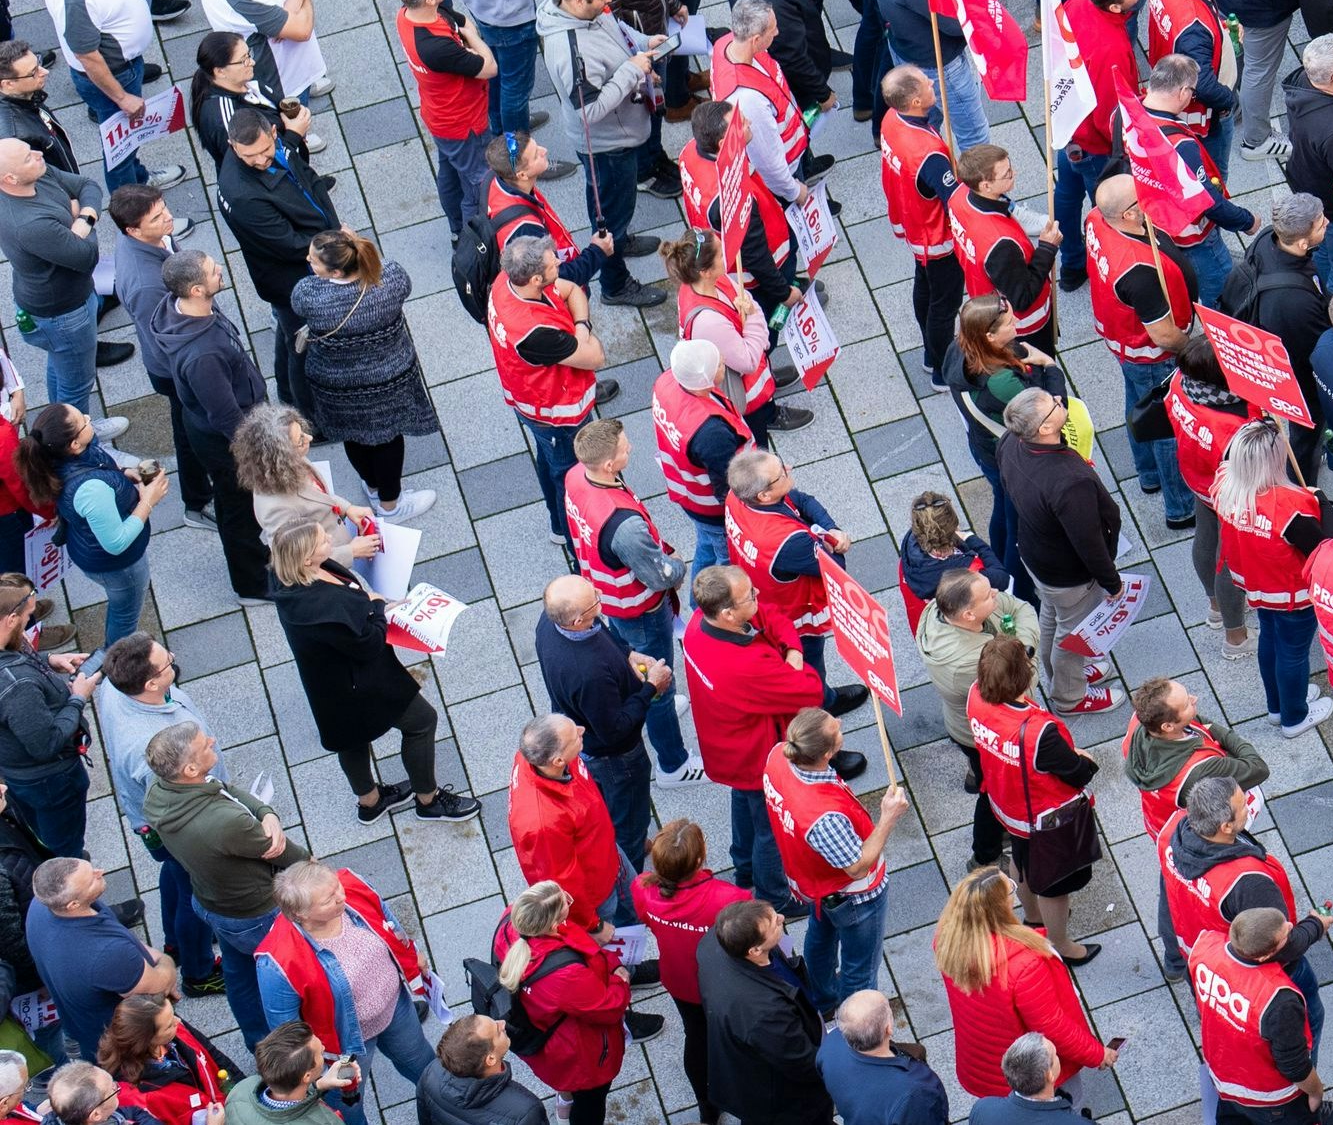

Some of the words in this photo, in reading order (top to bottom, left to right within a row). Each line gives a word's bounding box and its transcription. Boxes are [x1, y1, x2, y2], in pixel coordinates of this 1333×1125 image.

[106, 112, 163, 147] 11,6%
[1207, 322, 1232, 340] WIR
[1211, 333, 1264, 362] KÄMPFEN
[1215, 343, 1237, 362] FÜR
[1237, 351, 1291, 380] UNSEREN
[1220, 353, 1282, 385] KOLLEKTIV-
[1222, 361, 1279, 391] VERTRAG!
[1269, 396, 1308, 421] gpa
[647, 911, 710, 933] www.vida.at
[1196, 963, 1251, 1022] gpa
